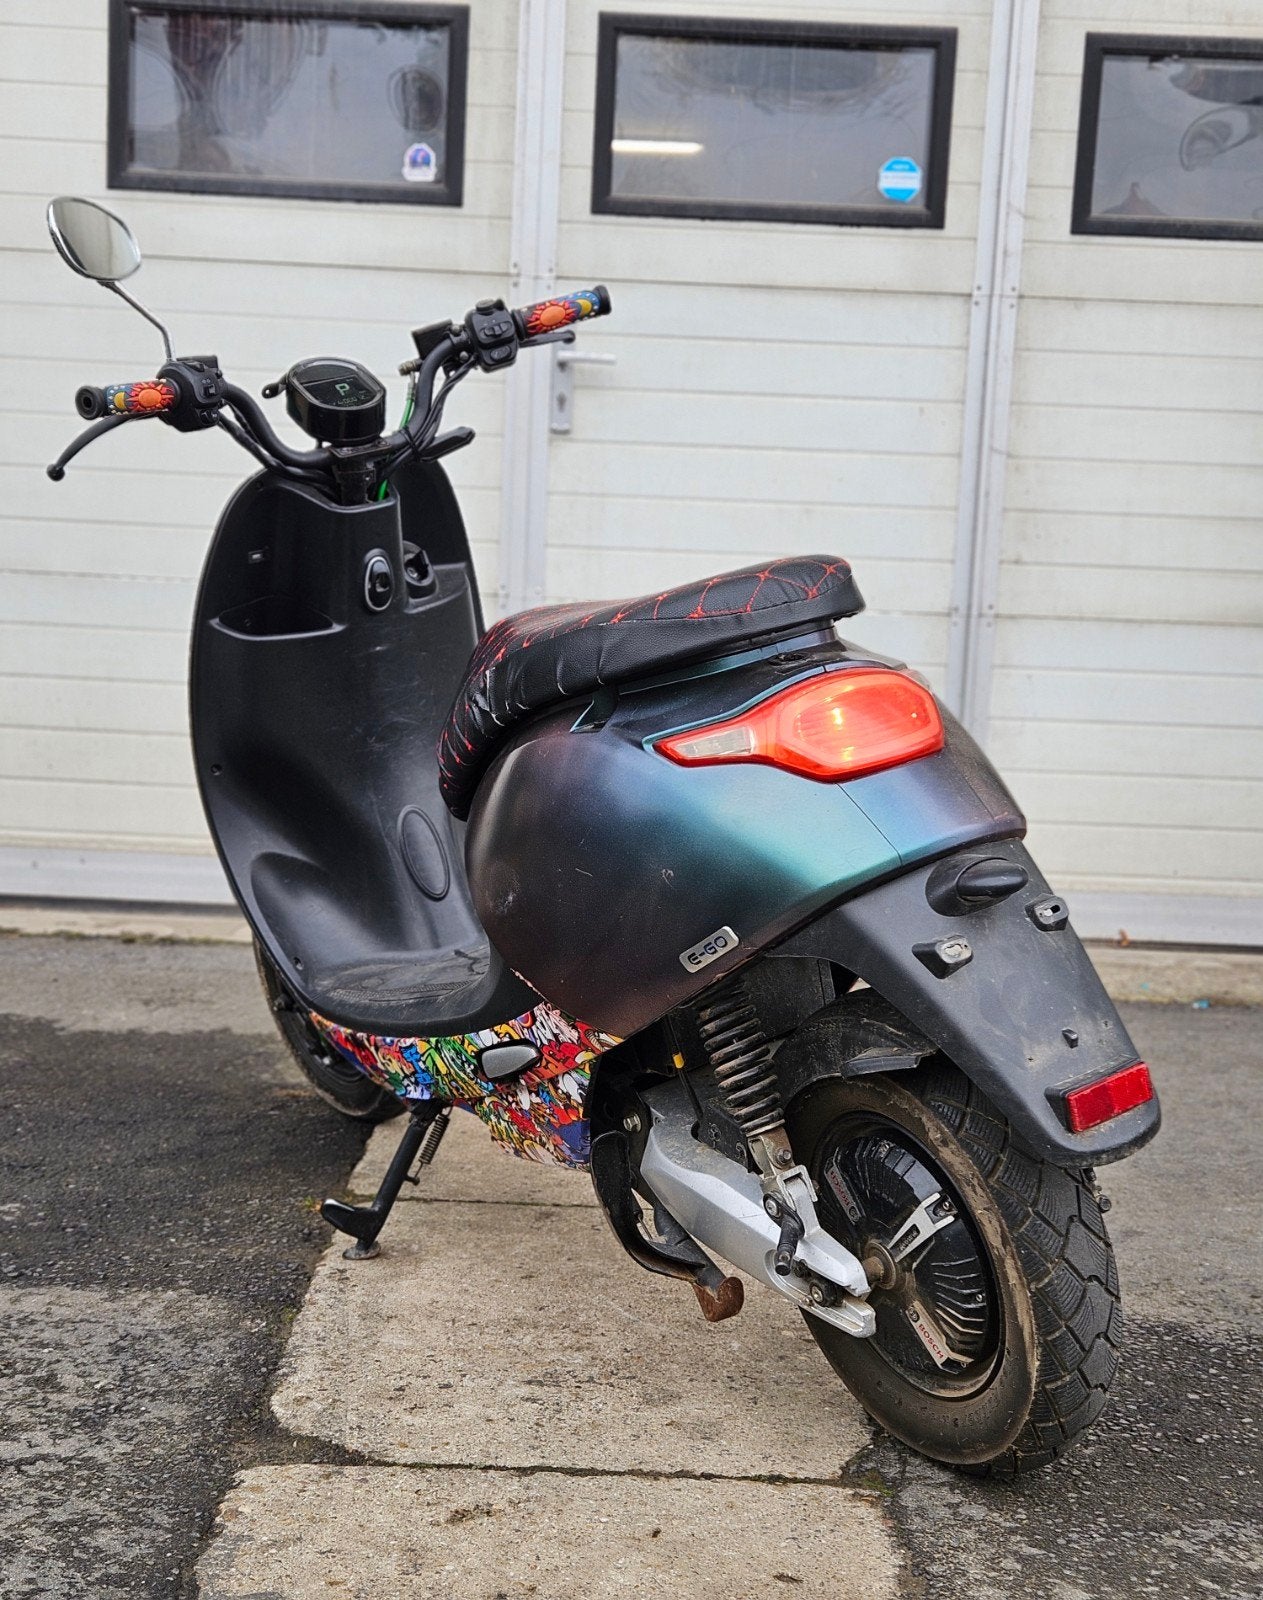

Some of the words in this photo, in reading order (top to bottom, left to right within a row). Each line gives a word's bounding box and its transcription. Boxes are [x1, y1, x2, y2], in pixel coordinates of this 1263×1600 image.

[335, 383, 350, 396] P
[687, 936, 728, 966] E-GO
[918, 1323, 944, 1359] BOSCH
